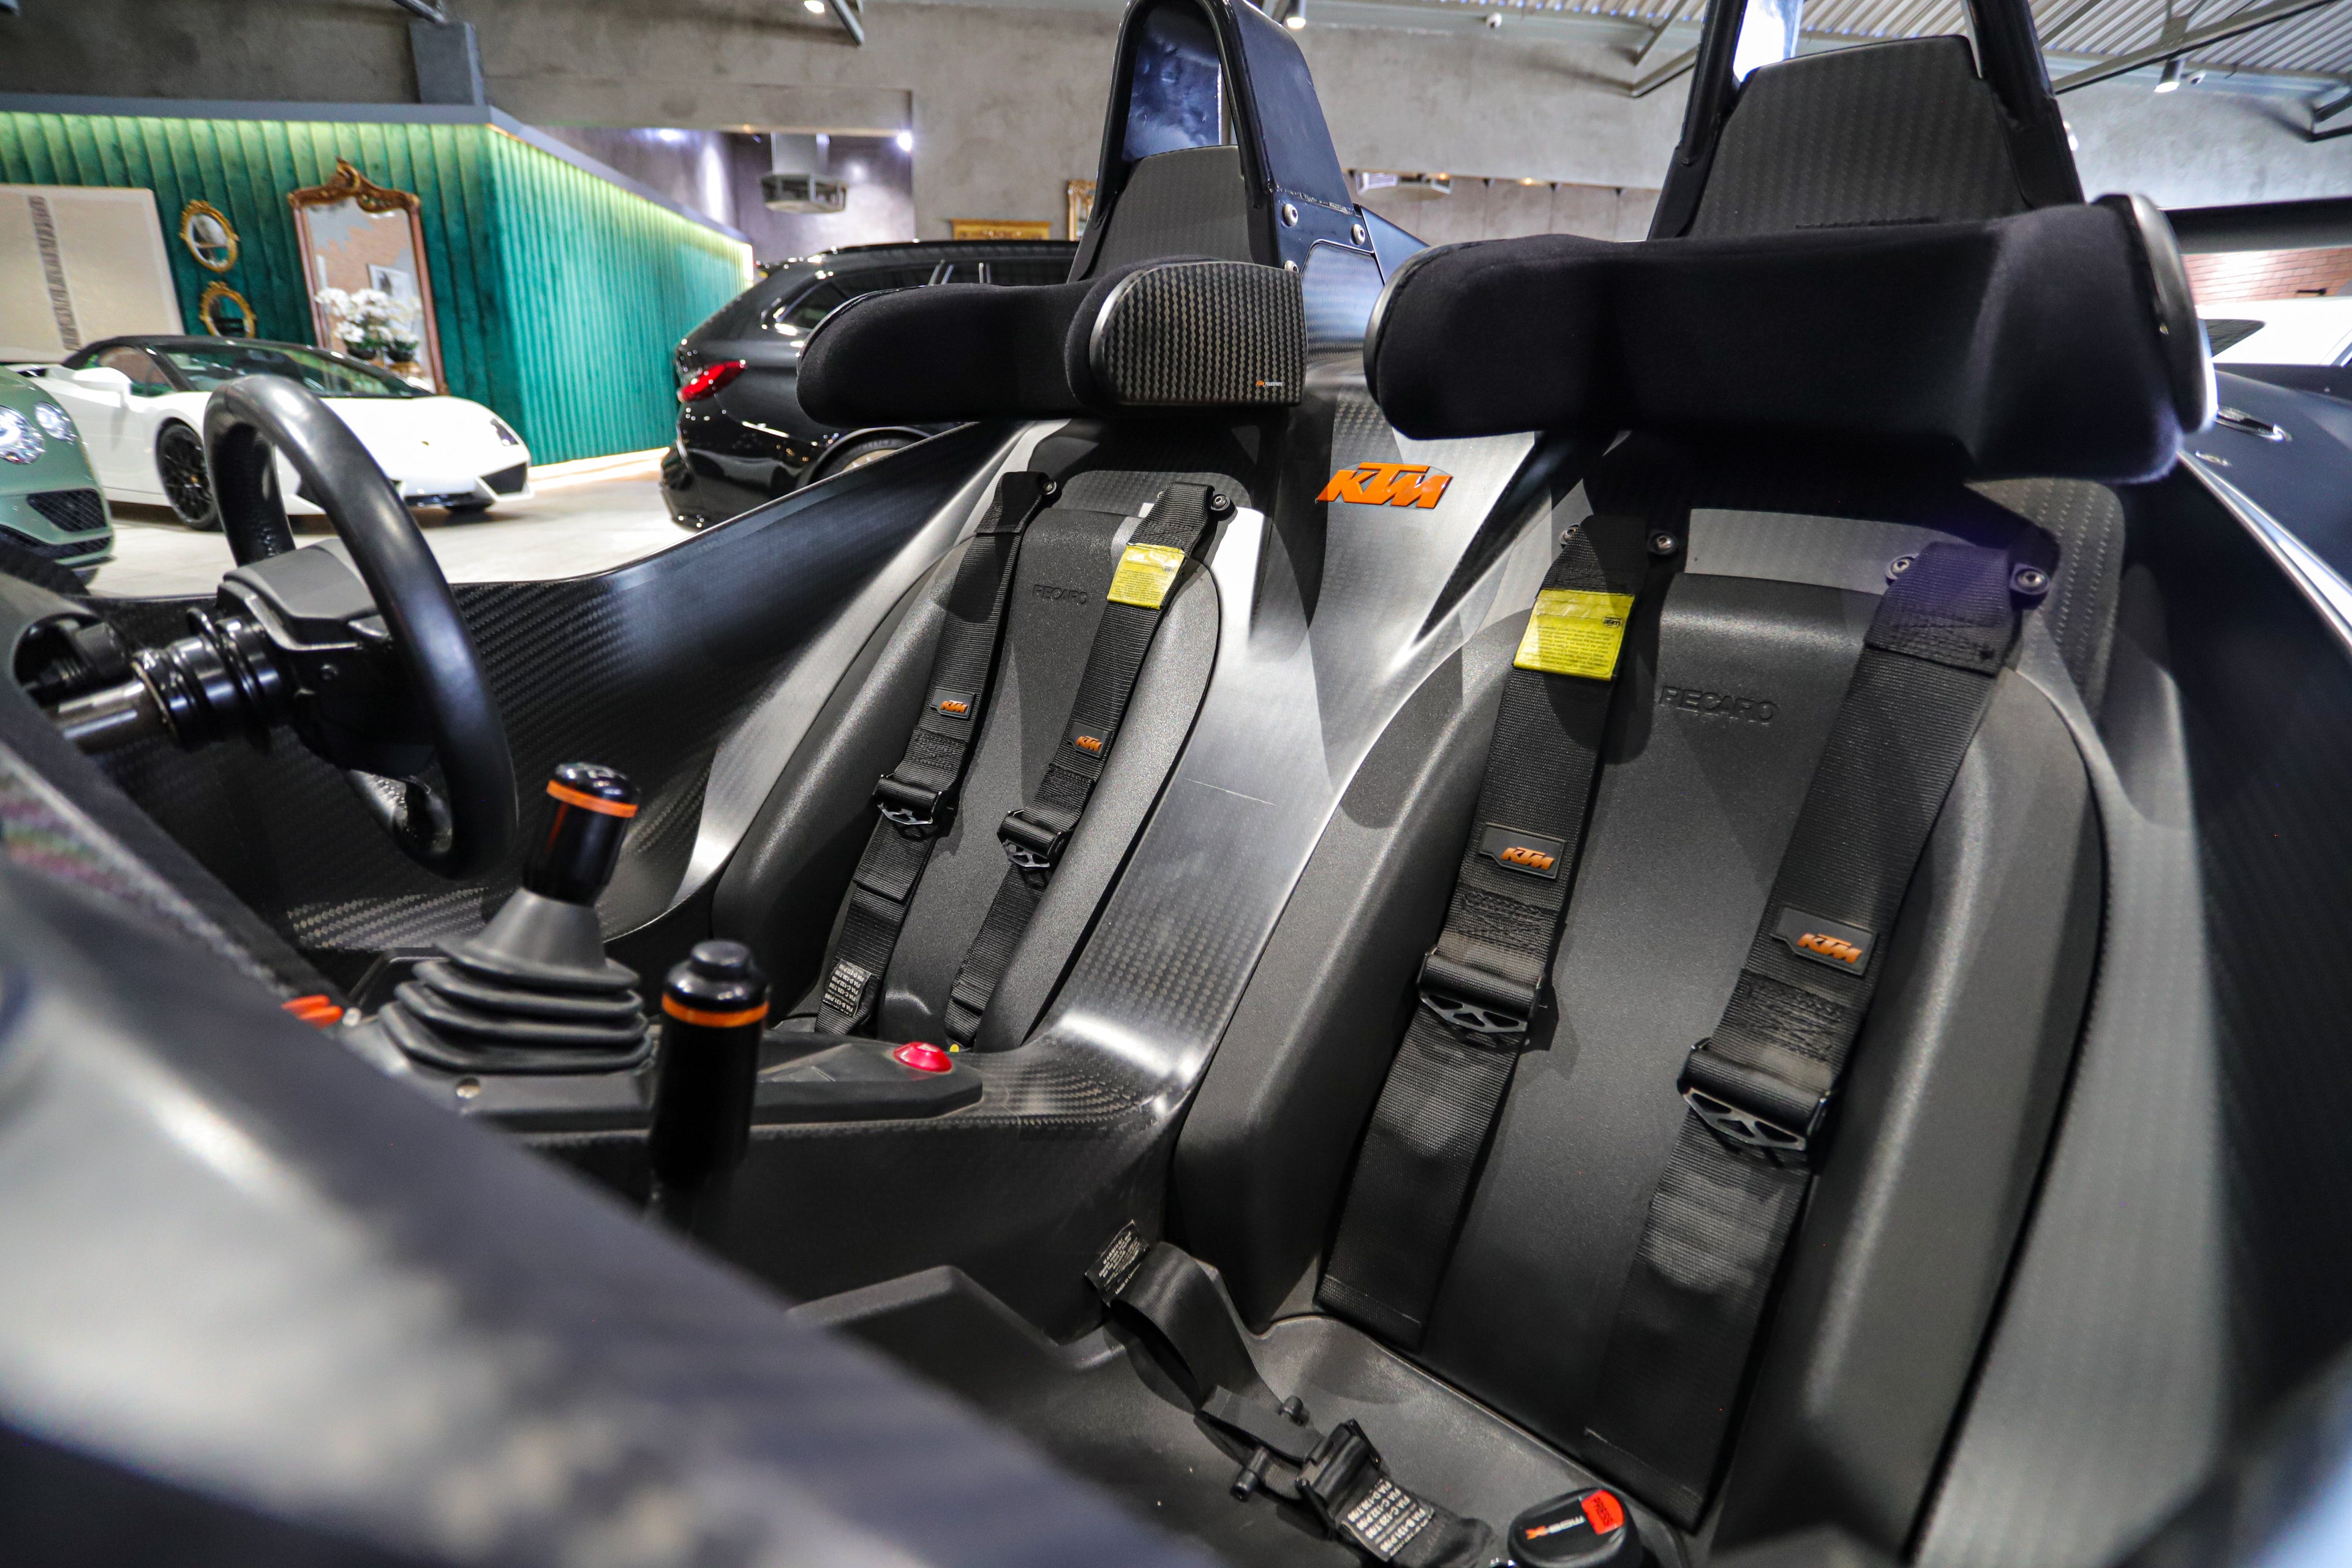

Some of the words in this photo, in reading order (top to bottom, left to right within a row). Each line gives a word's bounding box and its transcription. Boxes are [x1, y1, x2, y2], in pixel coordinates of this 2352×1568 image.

[1316, 462, 1452, 508] KTM
[941, 700, 968, 714] KTM
[1659, 685, 1778, 726] RECARO
[1076, 736, 1102, 752] KTM
[1501, 846, 1555, 870] KTM
[1797, 933, 1862, 964] KTM
